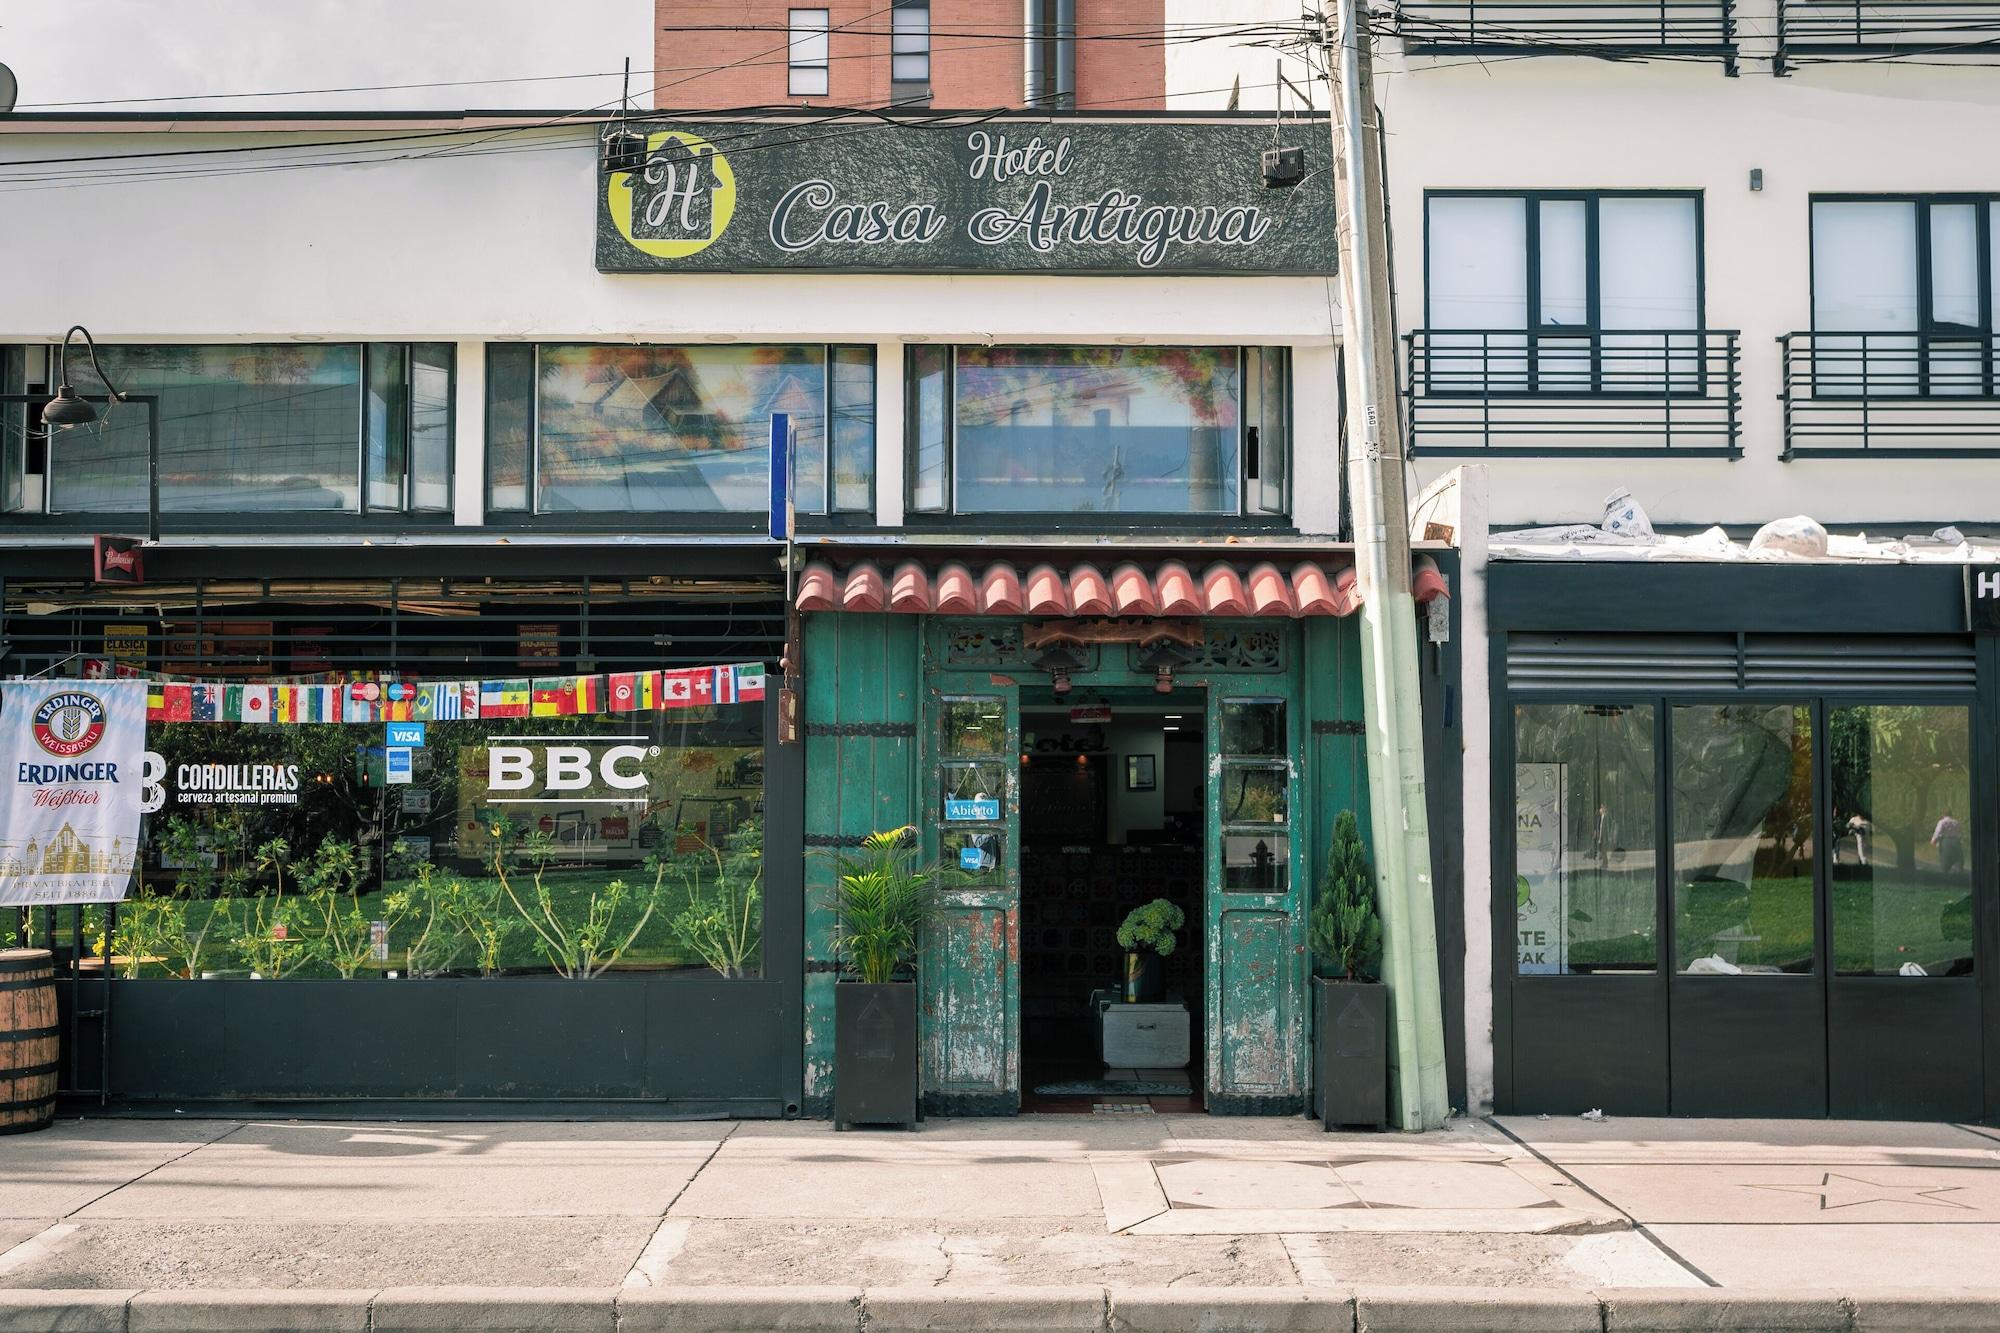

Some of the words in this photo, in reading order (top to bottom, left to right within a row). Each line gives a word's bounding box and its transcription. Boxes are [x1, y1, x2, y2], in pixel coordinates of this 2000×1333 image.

[967, 130, 1074, 182] Hotel
[769, 179, 946, 252] Casa
[967, 180, 1271, 268] Antigua
[38, 695, 101, 720] ERDINGER
[392, 731, 421, 742] VISA
[18, 762, 120, 785] ERDINGER
[177, 764, 299, 790] CORDILLERAS
[488, 745, 649, 790] BBC
[177, 793, 213, 803] cerveza
[215, 791, 259, 803] artesanal
[952, 804, 993, 816] Abierto
